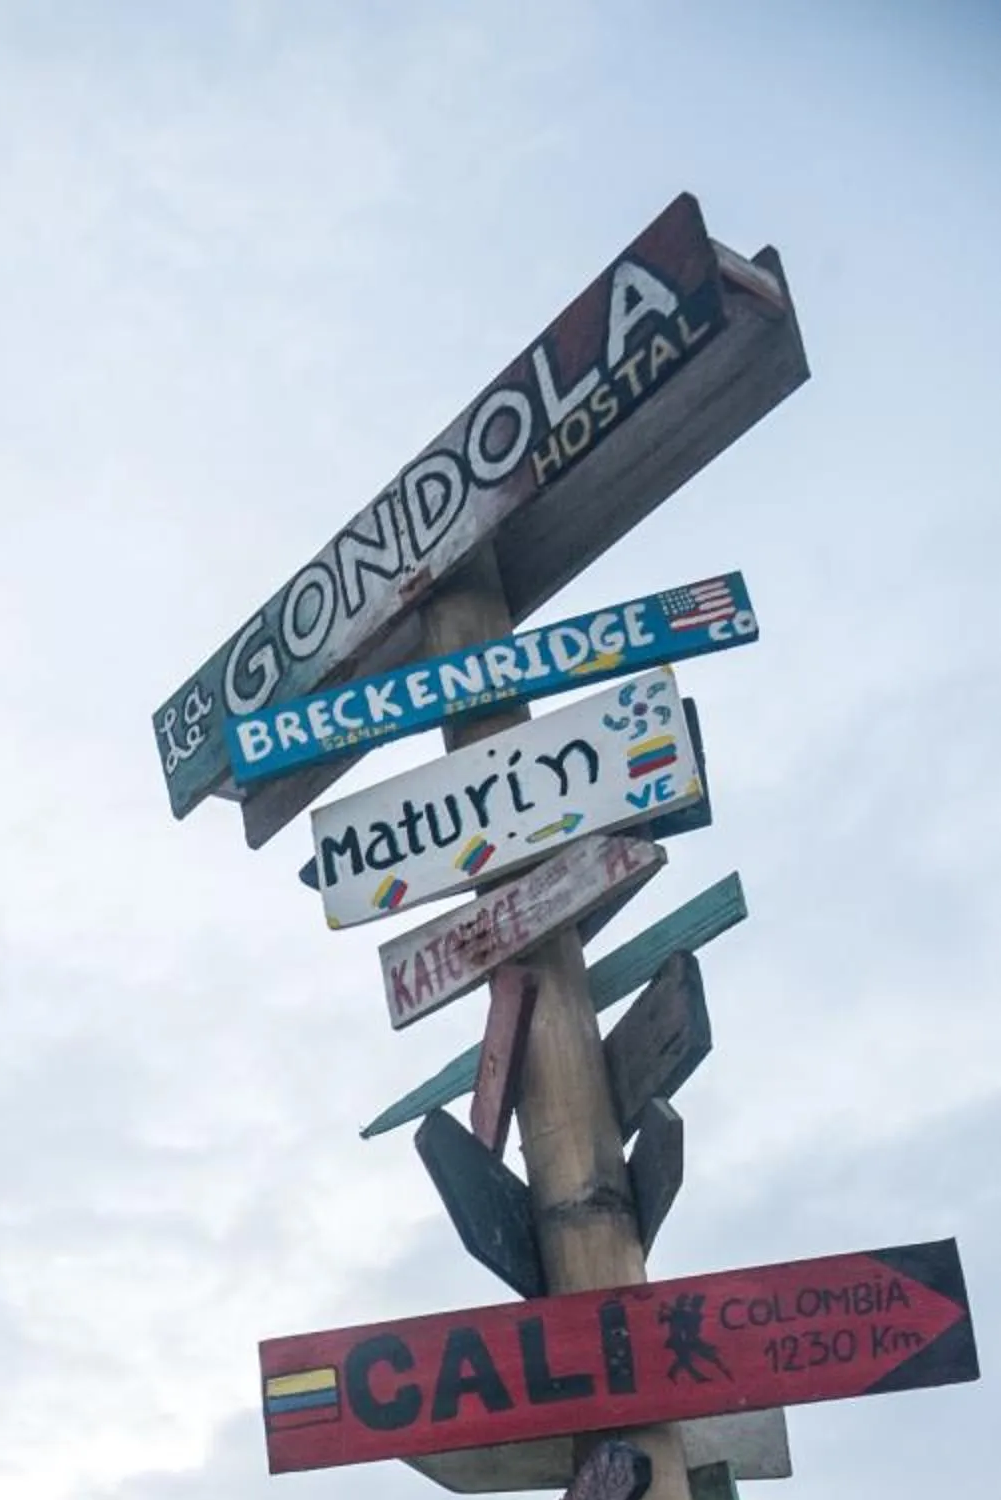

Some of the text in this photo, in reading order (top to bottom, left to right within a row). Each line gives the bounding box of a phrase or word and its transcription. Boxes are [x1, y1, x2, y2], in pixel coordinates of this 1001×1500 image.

[532, 313, 710, 486] HOSTAL
[221, 256, 681, 717] GONDOLA
[236, 602, 655, 763] BRECKENRIDGE
[709, 610, 756, 641] CO
[319, 734, 601, 888] Maturín
[625, 773, 676, 809] VE
[343, 1299, 637, 1432] CALI
[765, 1322, 928, 1374] 1230 Km
